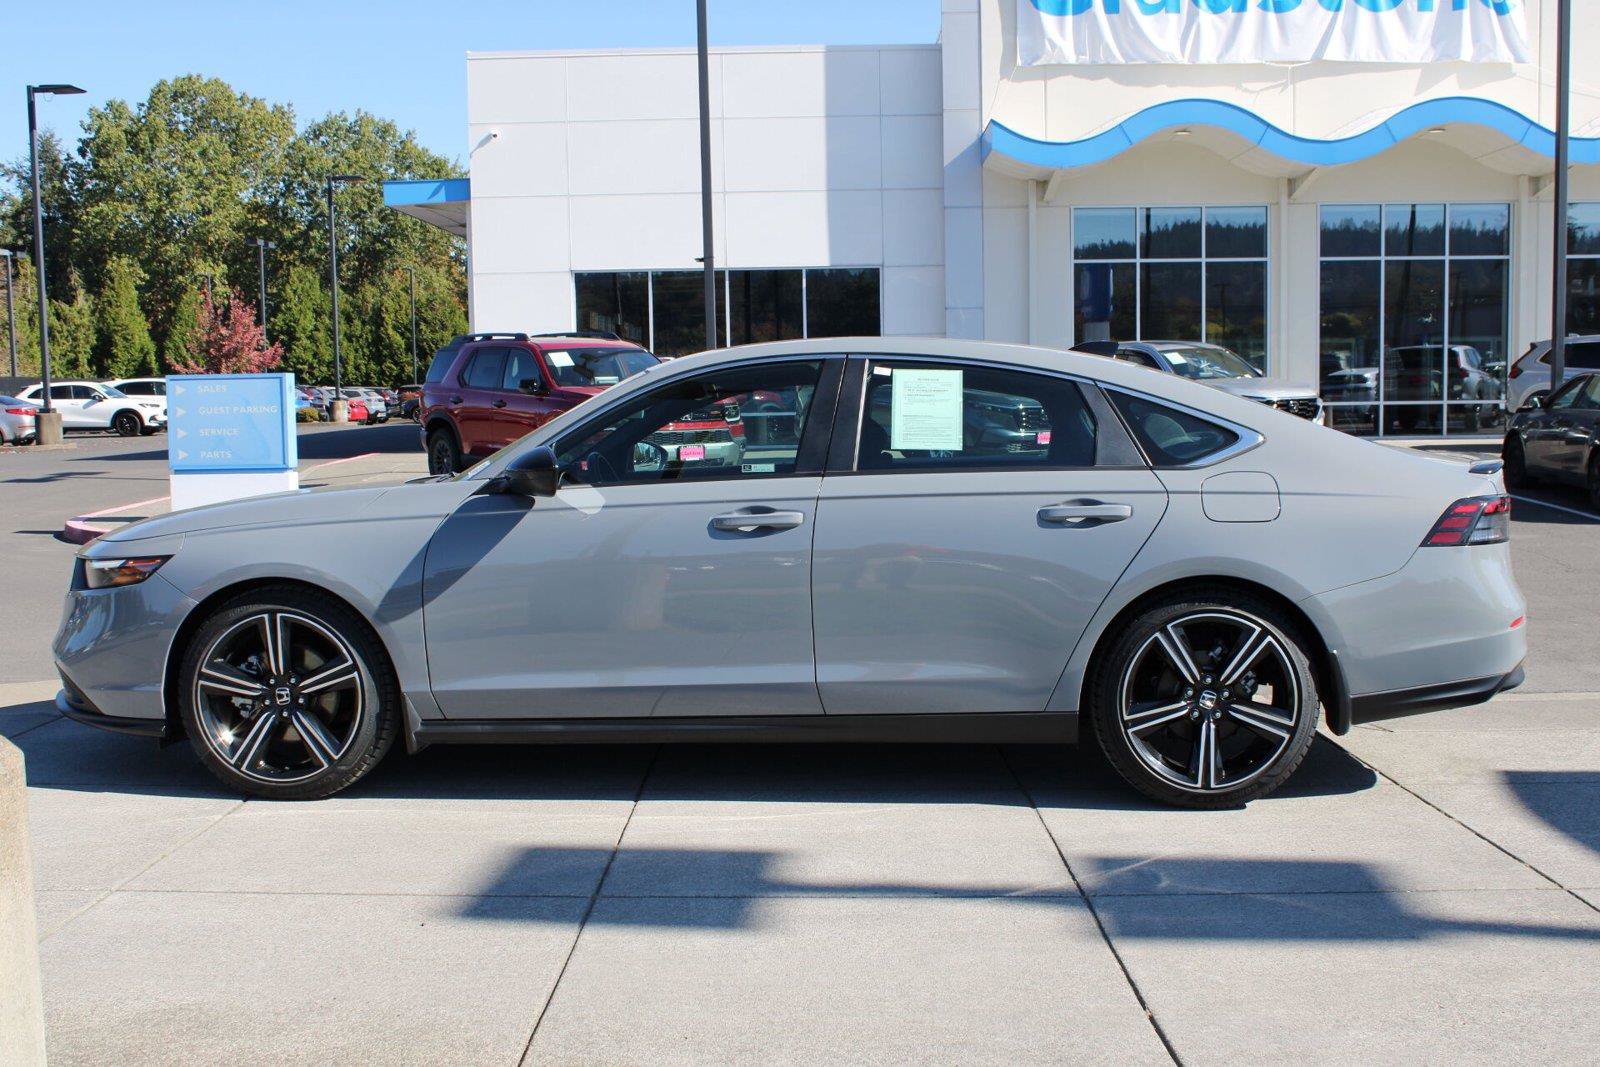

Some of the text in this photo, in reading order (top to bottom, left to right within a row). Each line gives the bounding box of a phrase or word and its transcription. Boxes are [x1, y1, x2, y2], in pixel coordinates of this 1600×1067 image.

[197, 384, 228, 393] SALES
[199, 405, 278, 415] GUEST PARKING
[199, 427, 240, 437] SERVICE
[200, 450, 232, 459] PARTS
